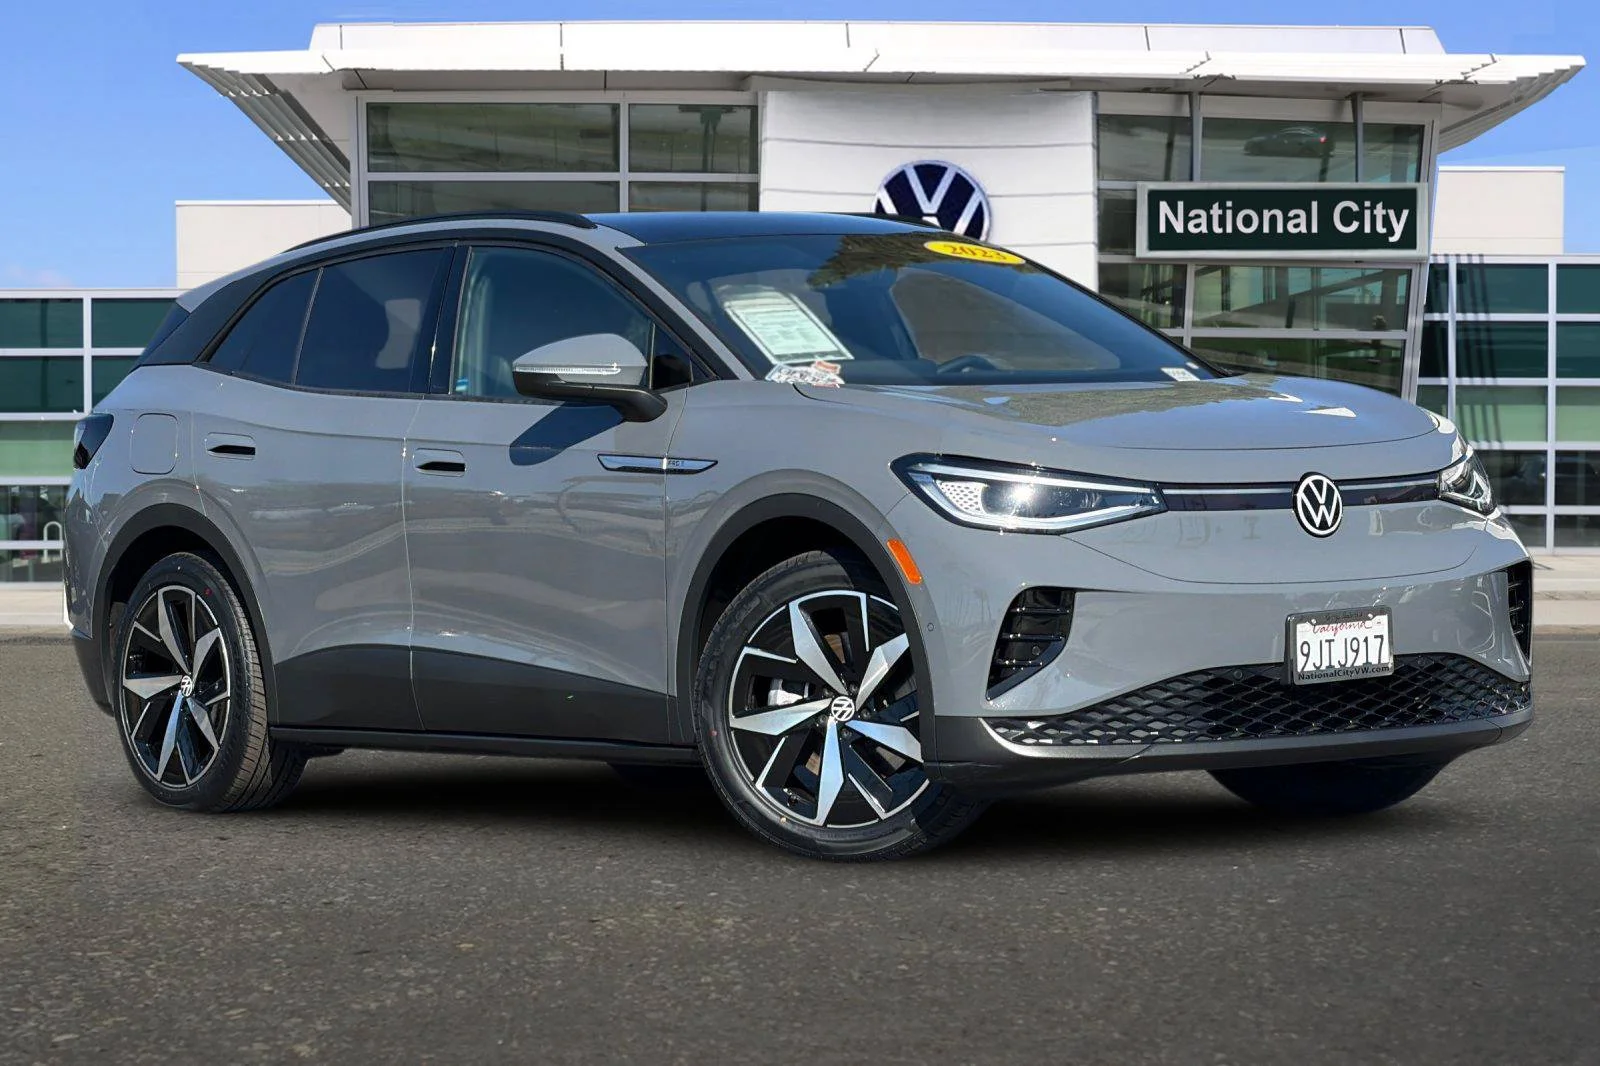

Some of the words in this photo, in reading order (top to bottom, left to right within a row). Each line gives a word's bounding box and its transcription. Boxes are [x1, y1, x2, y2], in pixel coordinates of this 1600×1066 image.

[1159, 200, 1318, 234] National
[1333, 200, 1409, 243] City
[944, 244, 1007, 260] 2023
[1297, 475, 1342, 535] VW
[1298, 666, 1390, 681] NationalCityVW.com
